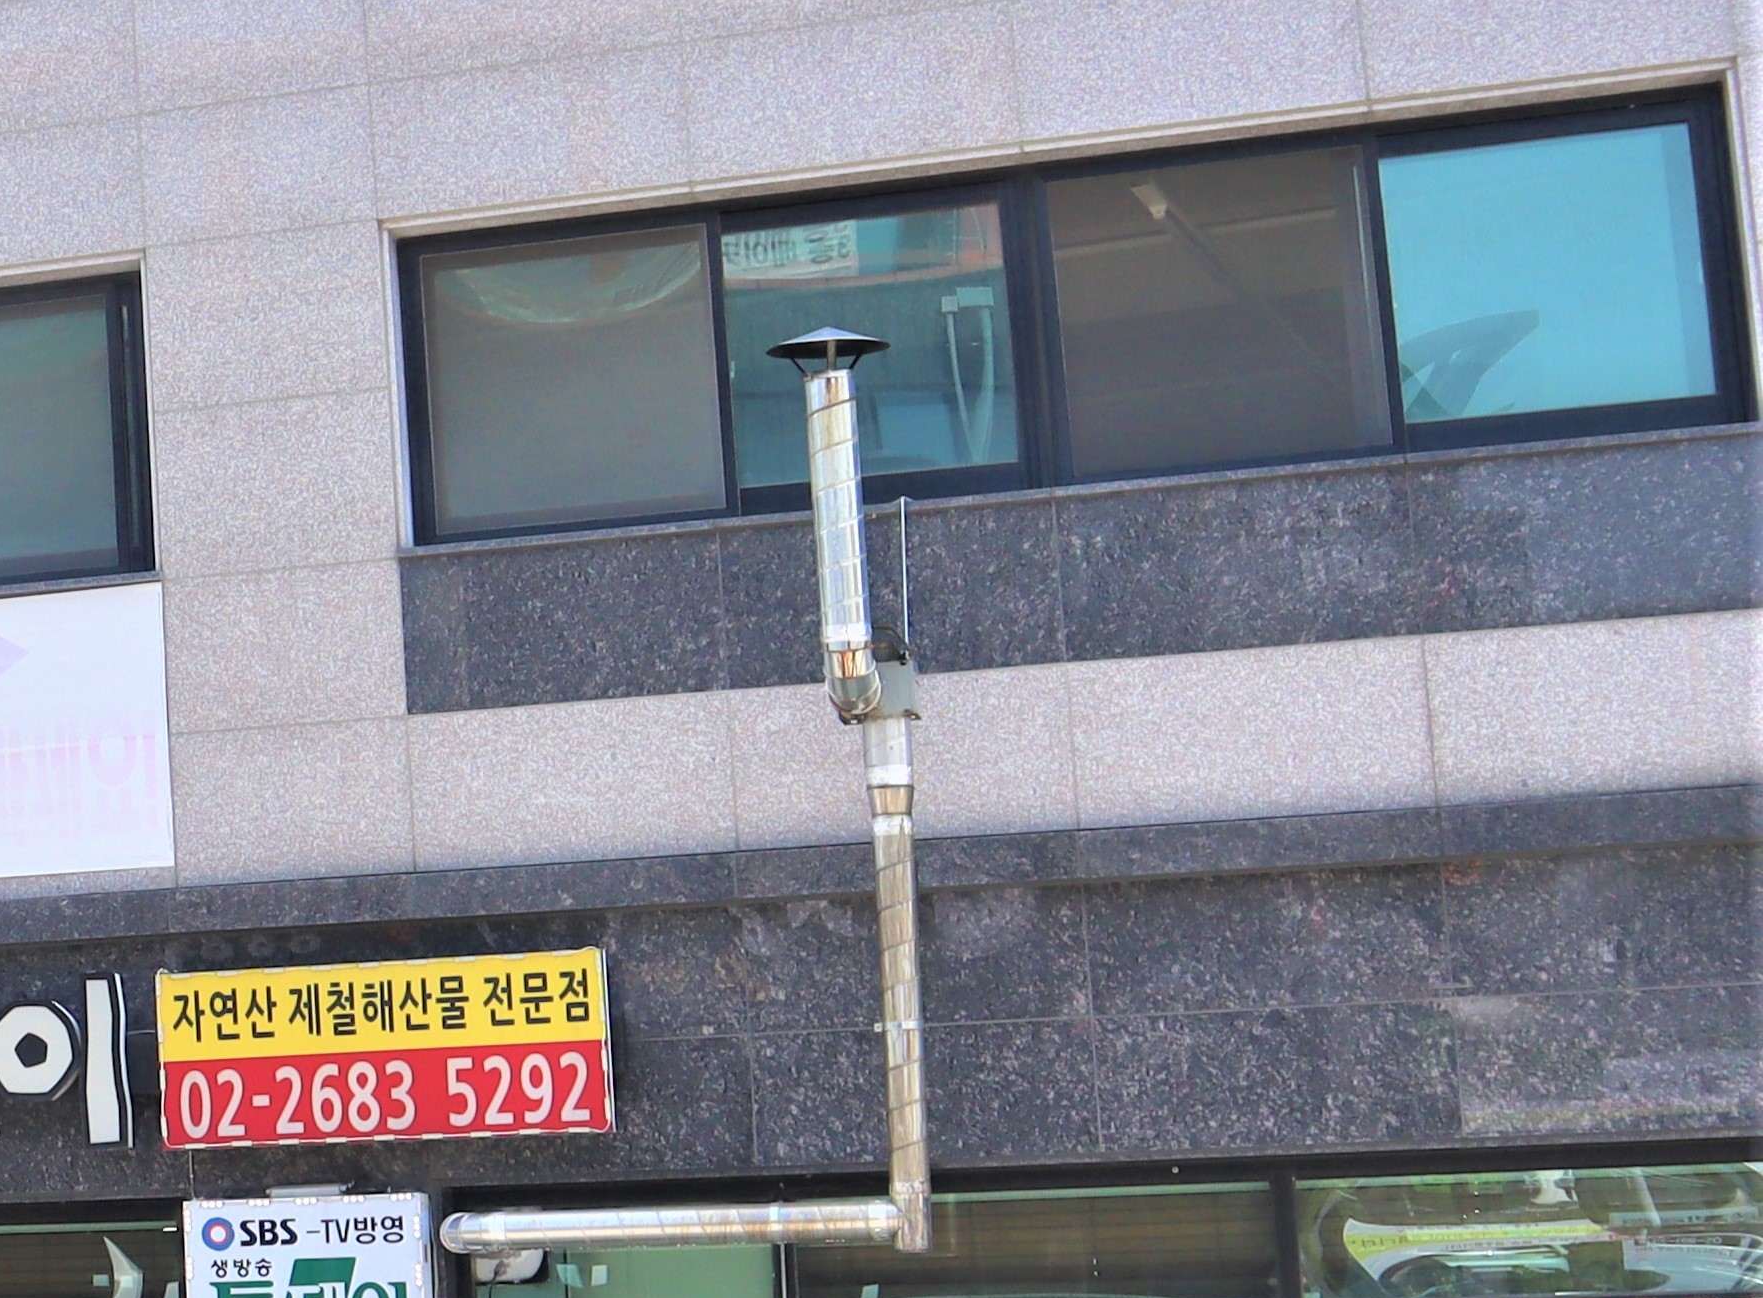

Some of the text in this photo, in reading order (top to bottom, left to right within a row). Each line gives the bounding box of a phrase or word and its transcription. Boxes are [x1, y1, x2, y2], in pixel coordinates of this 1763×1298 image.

[170, 966, 592, 1043] 자연산 제철해산물 전문점
[178, 1050, 593, 1140] 02-2683 5292
[239, 1218, 299, 1248] SBS
[209, 1258, 273, 1279] 생방송
